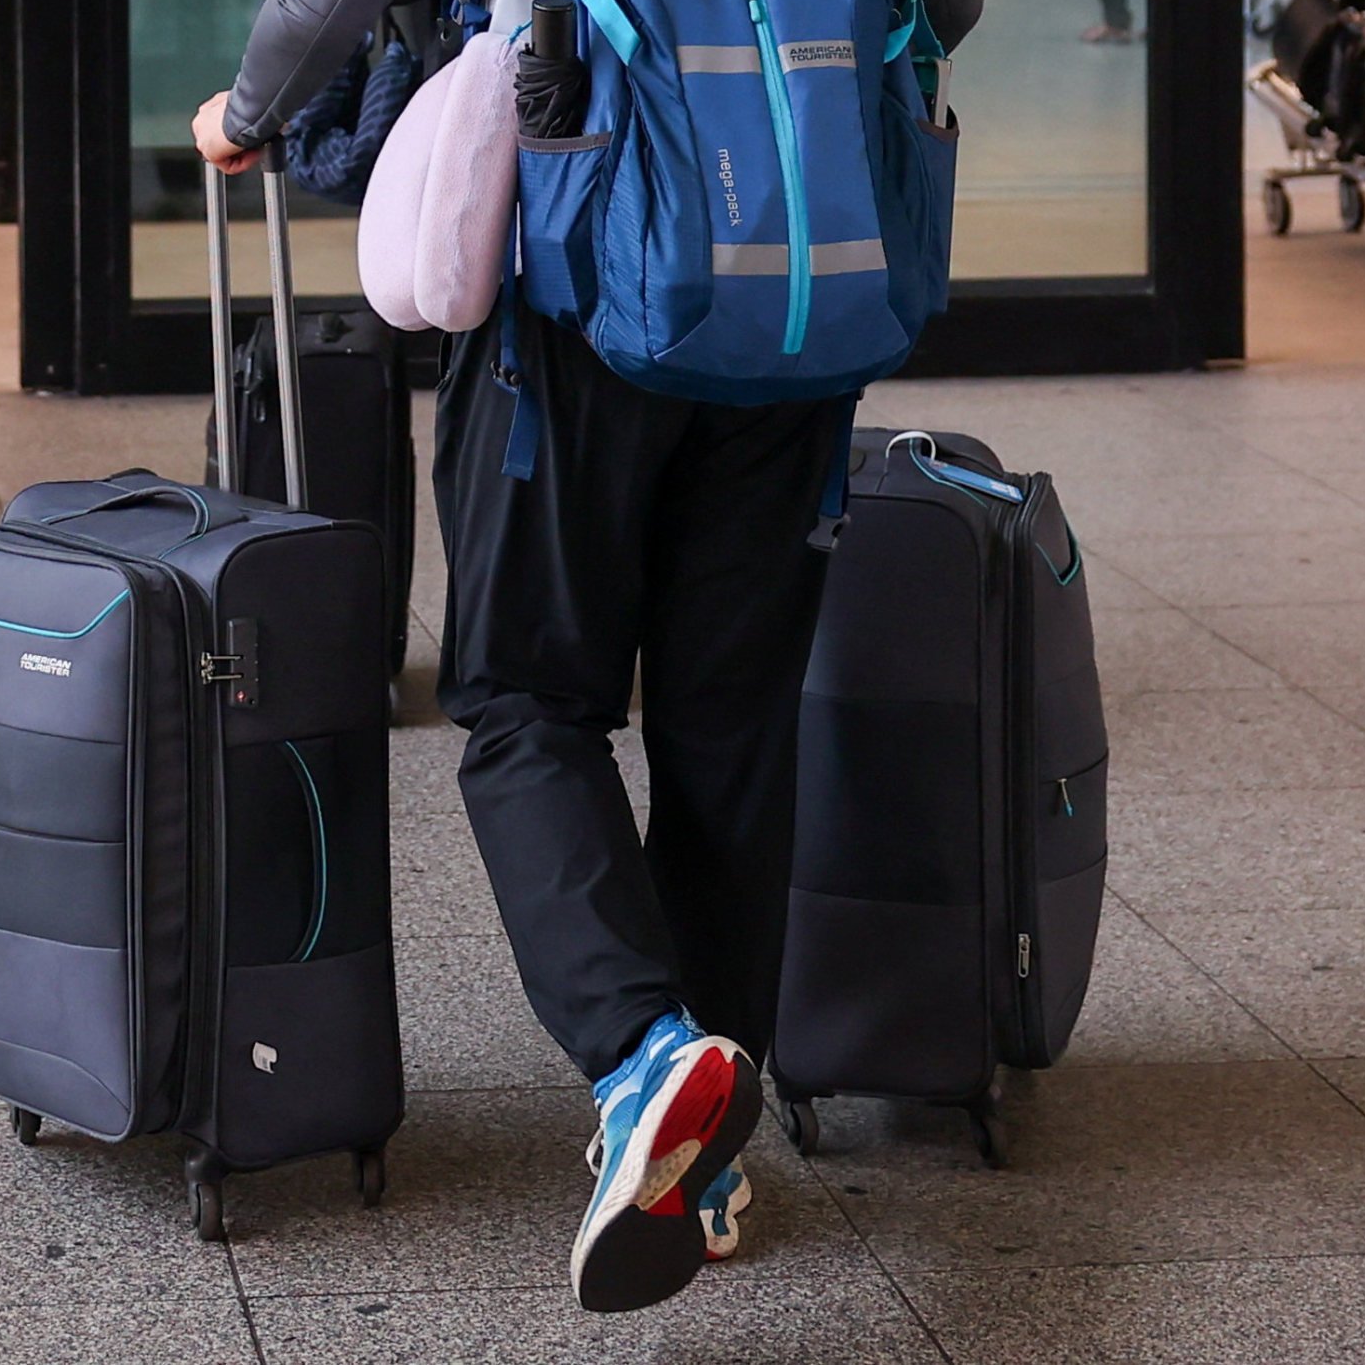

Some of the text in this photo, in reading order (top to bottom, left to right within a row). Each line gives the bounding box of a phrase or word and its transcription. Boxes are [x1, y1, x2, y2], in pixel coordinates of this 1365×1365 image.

[789, 46, 852, 55] AMERICAN
[790, 52, 852, 62] TOURISTER
[717, 148, 743, 227] mega-pack
[19, 660, 71, 677] TOURISTER
[20, 653, 72, 669] AMERICAN
